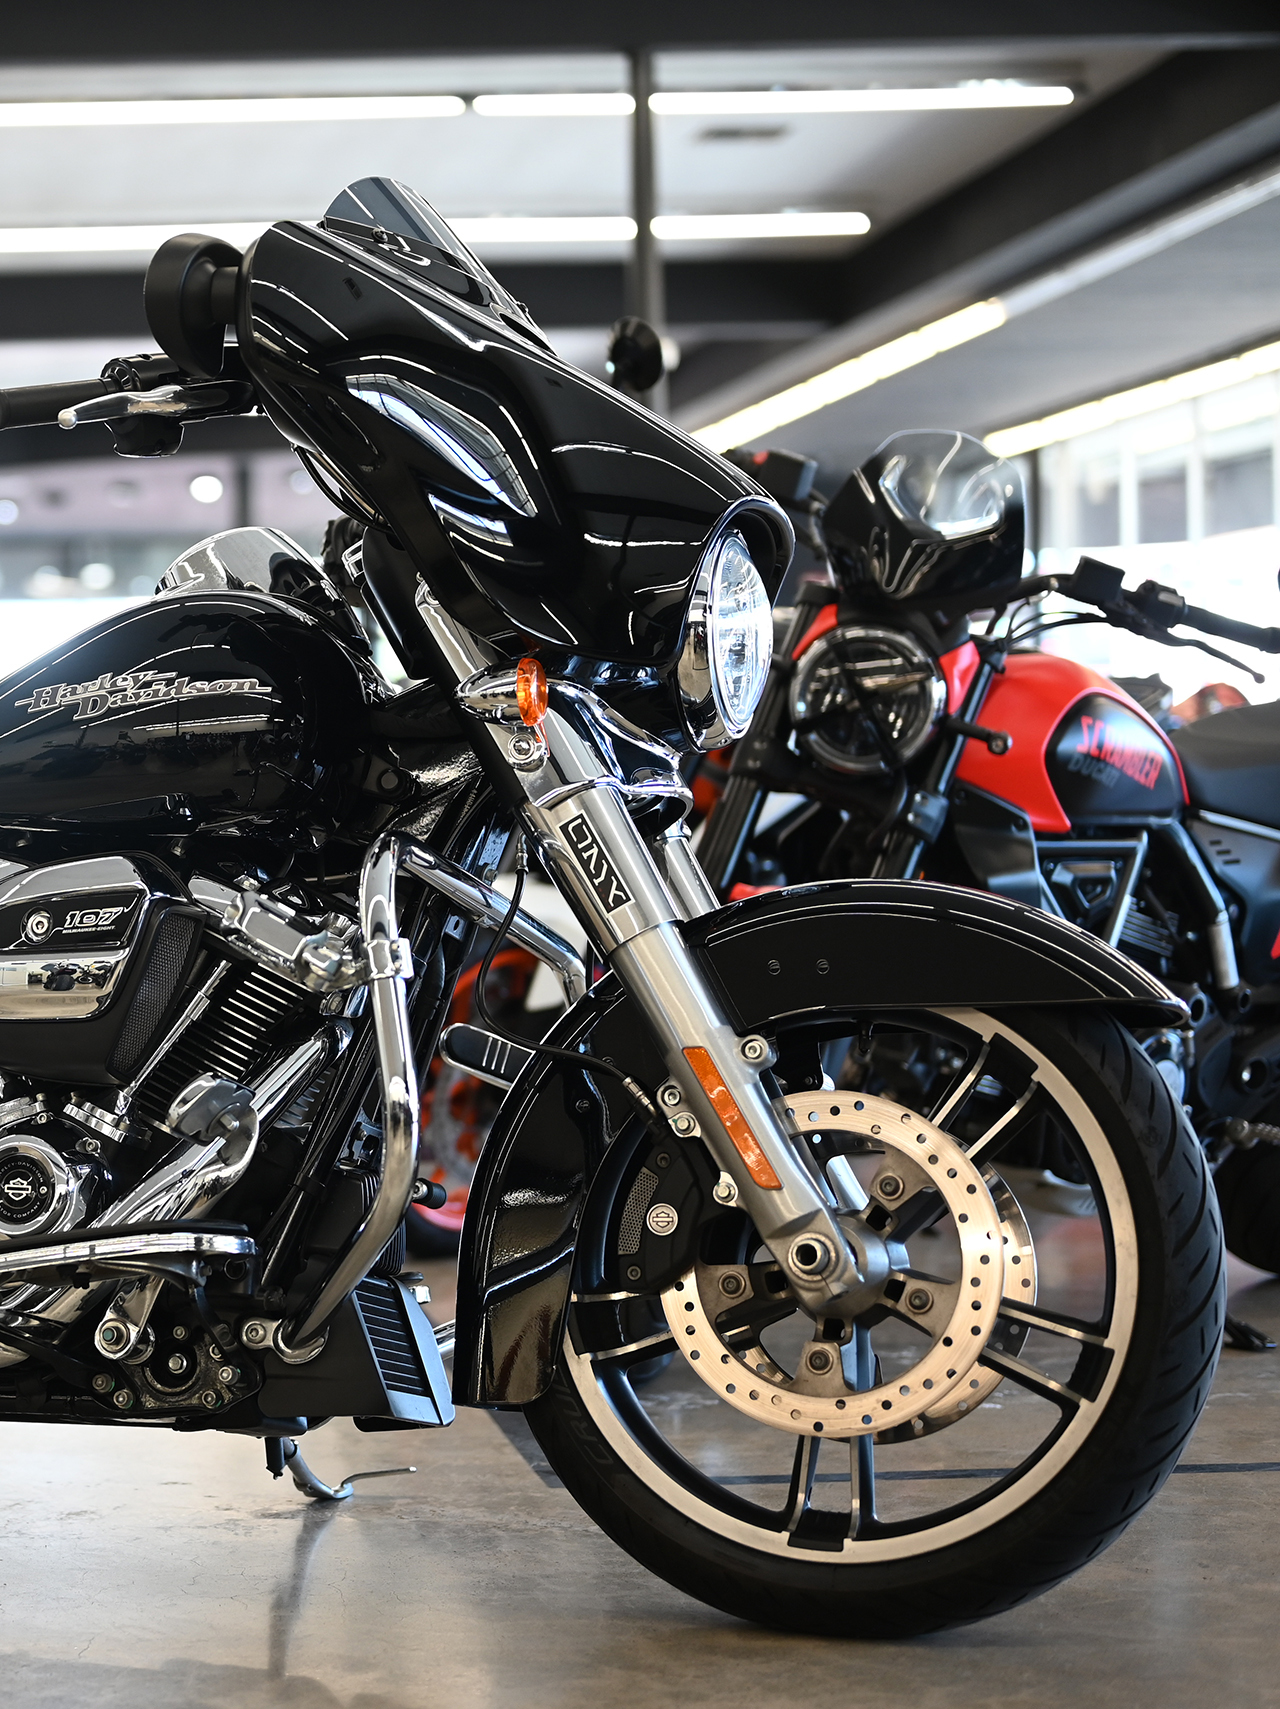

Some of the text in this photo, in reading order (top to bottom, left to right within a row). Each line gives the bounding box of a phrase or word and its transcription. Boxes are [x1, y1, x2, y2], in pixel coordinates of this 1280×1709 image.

[14, 670, 179, 714] Harley
[61, 677, 272, 722] Davidson
[64, 906, 124, 928] 107
[13, 1201, 41, 1218] COMPANY
